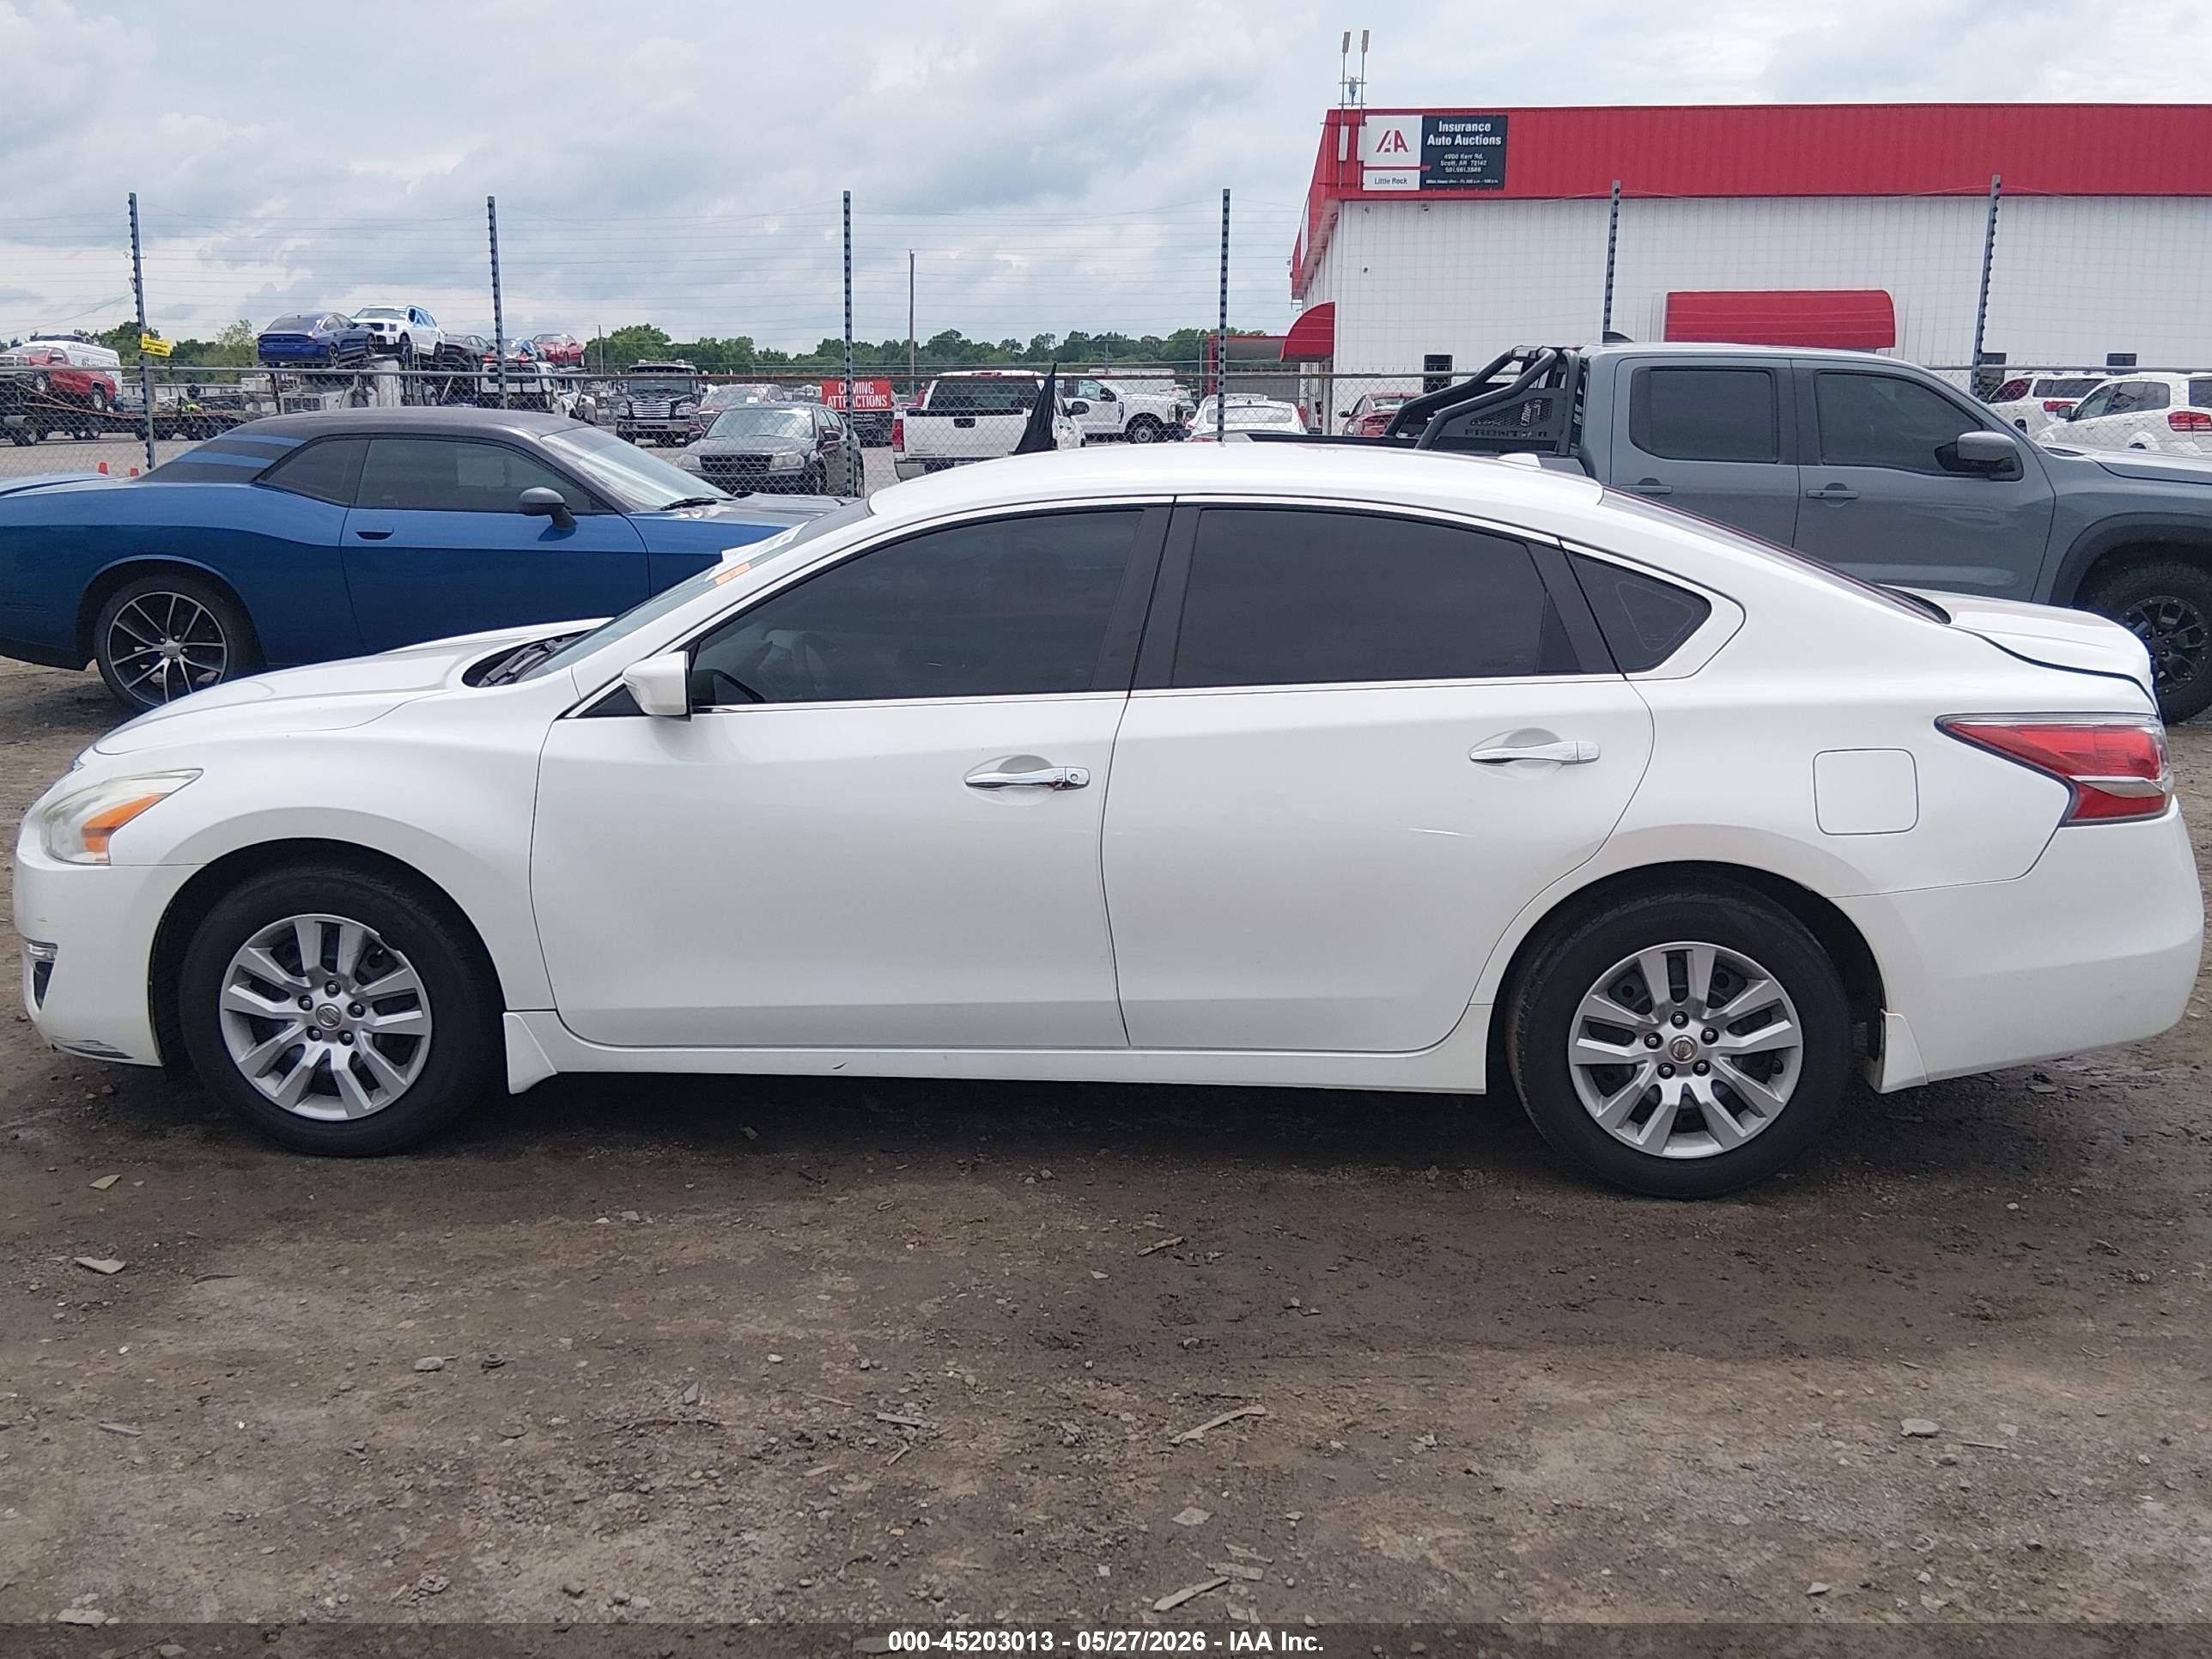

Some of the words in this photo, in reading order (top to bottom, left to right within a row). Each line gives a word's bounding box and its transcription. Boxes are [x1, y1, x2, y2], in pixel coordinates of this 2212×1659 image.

[1438, 120, 1492, 132] Insurance
[1426, 134, 1452, 146] Auto
[1454, 133, 1502, 146] Auctions
